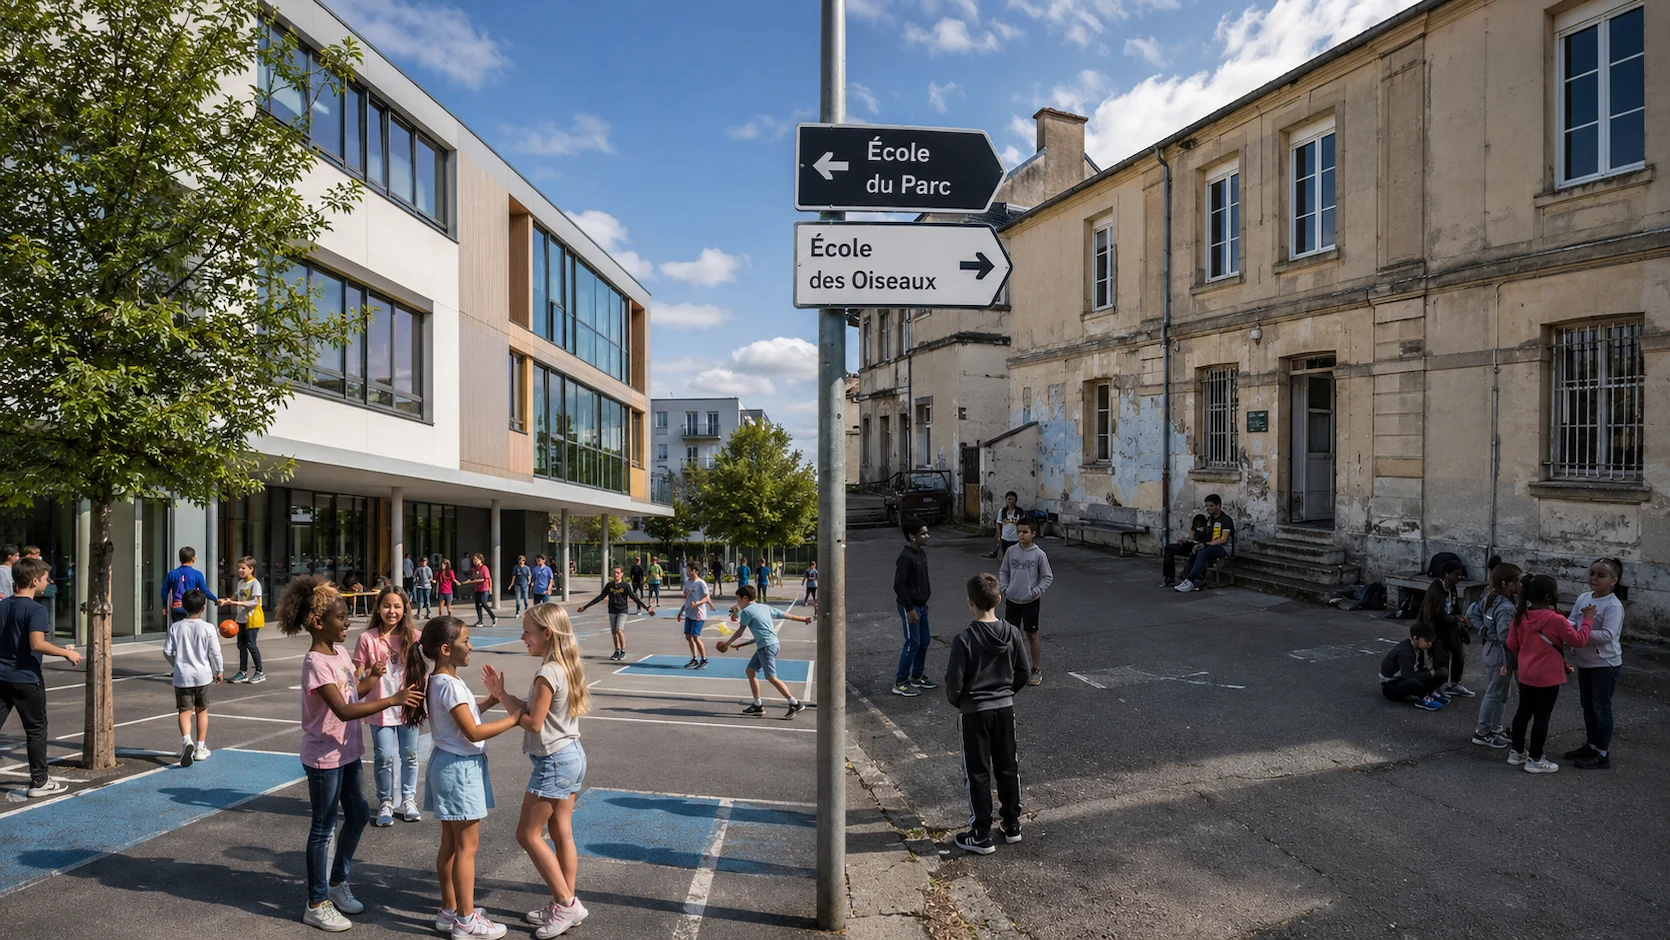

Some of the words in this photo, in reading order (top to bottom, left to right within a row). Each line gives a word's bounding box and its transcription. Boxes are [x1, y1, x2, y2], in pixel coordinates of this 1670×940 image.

[868, 136, 930, 162] École
[866, 174, 893, 193] du
[901, 175, 951, 195] Parc
[810, 233, 872, 257] École
[809, 270, 845, 289] des
[852, 270, 936, 290] Oiseaux
